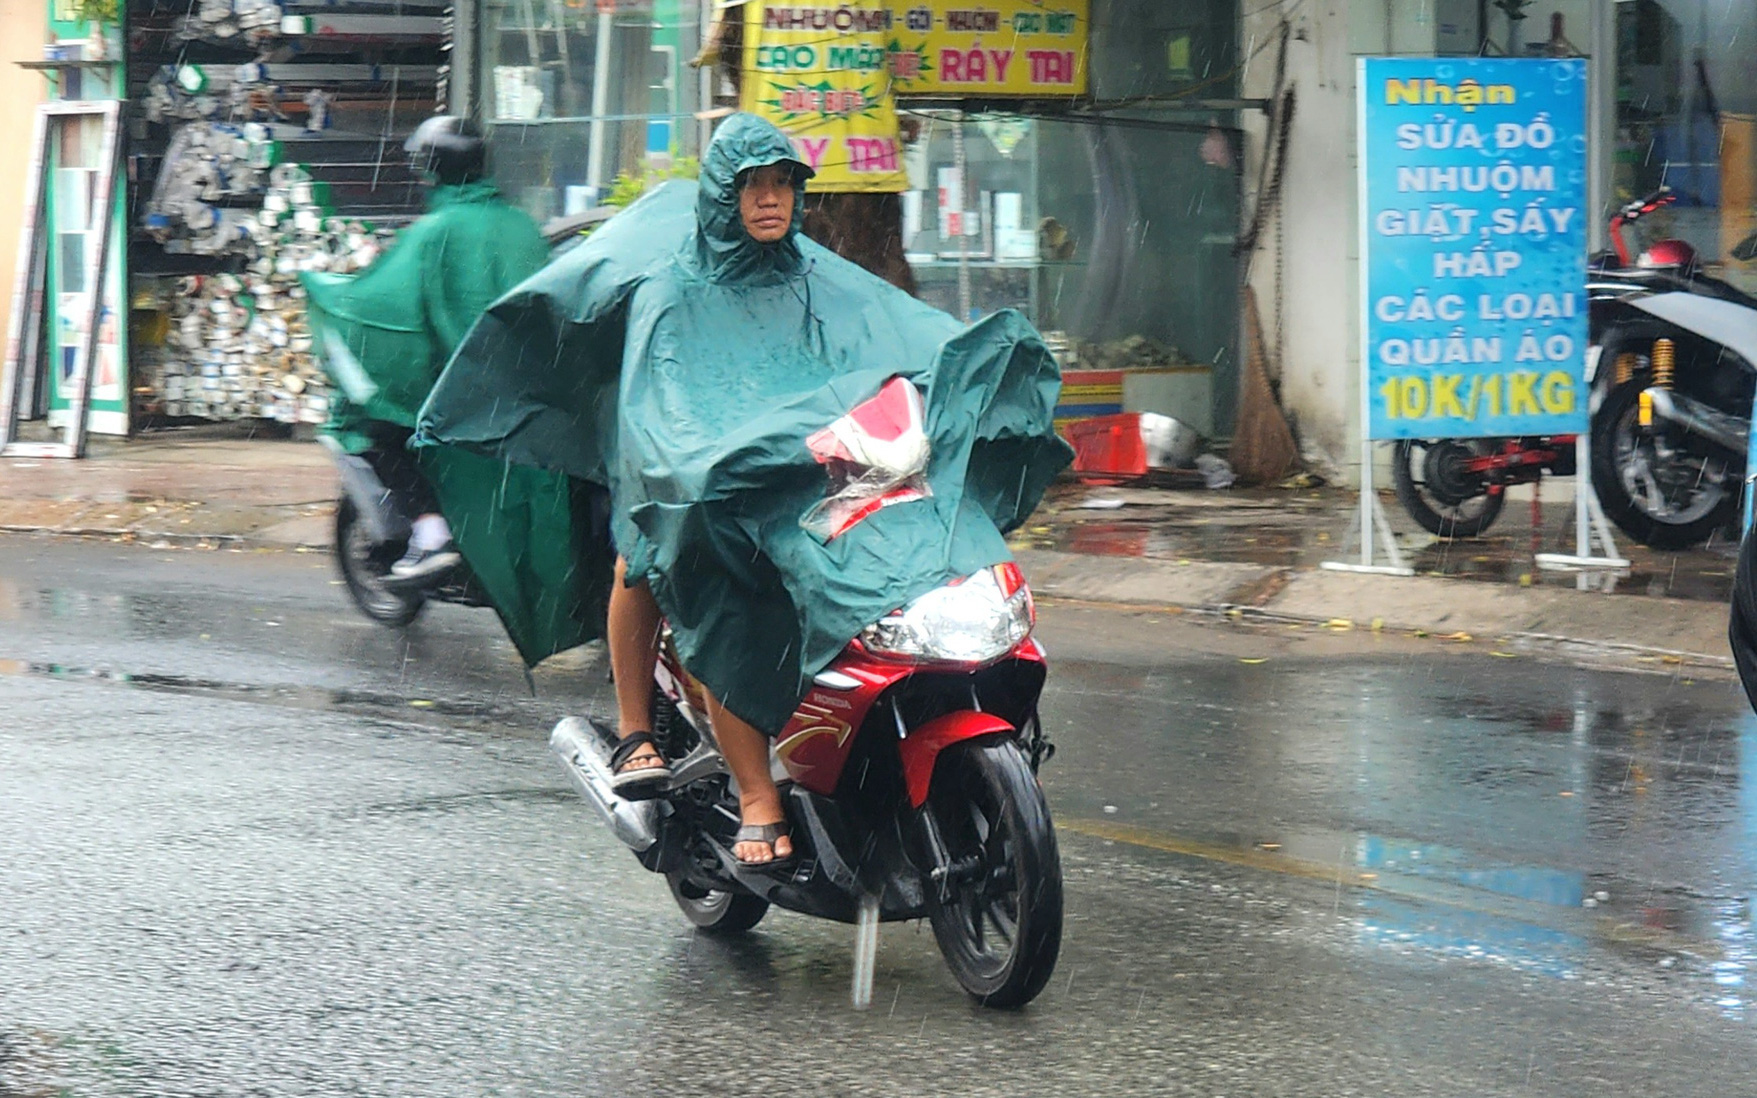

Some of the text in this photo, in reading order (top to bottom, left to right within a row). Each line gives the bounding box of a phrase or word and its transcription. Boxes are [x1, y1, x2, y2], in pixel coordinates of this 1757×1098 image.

[756, 45, 815, 73] CẠO
[939, 40, 1016, 83] RÁY
[1027, 50, 1075, 84] TAI
[1385, 78, 1517, 113] Nhận
[1396, 113, 1483, 150] SỬA
[1397, 160, 1556, 199] NHUỘM
[1492, 197, 1577, 236] SẤY
[1433, 239, 1522, 279] HẤP
[1375, 288, 1576, 327] CÁC LOẠI
[1379, 326, 1574, 366] QUẦN ÁO
[1380, 371, 1576, 421] 10K/1KG
